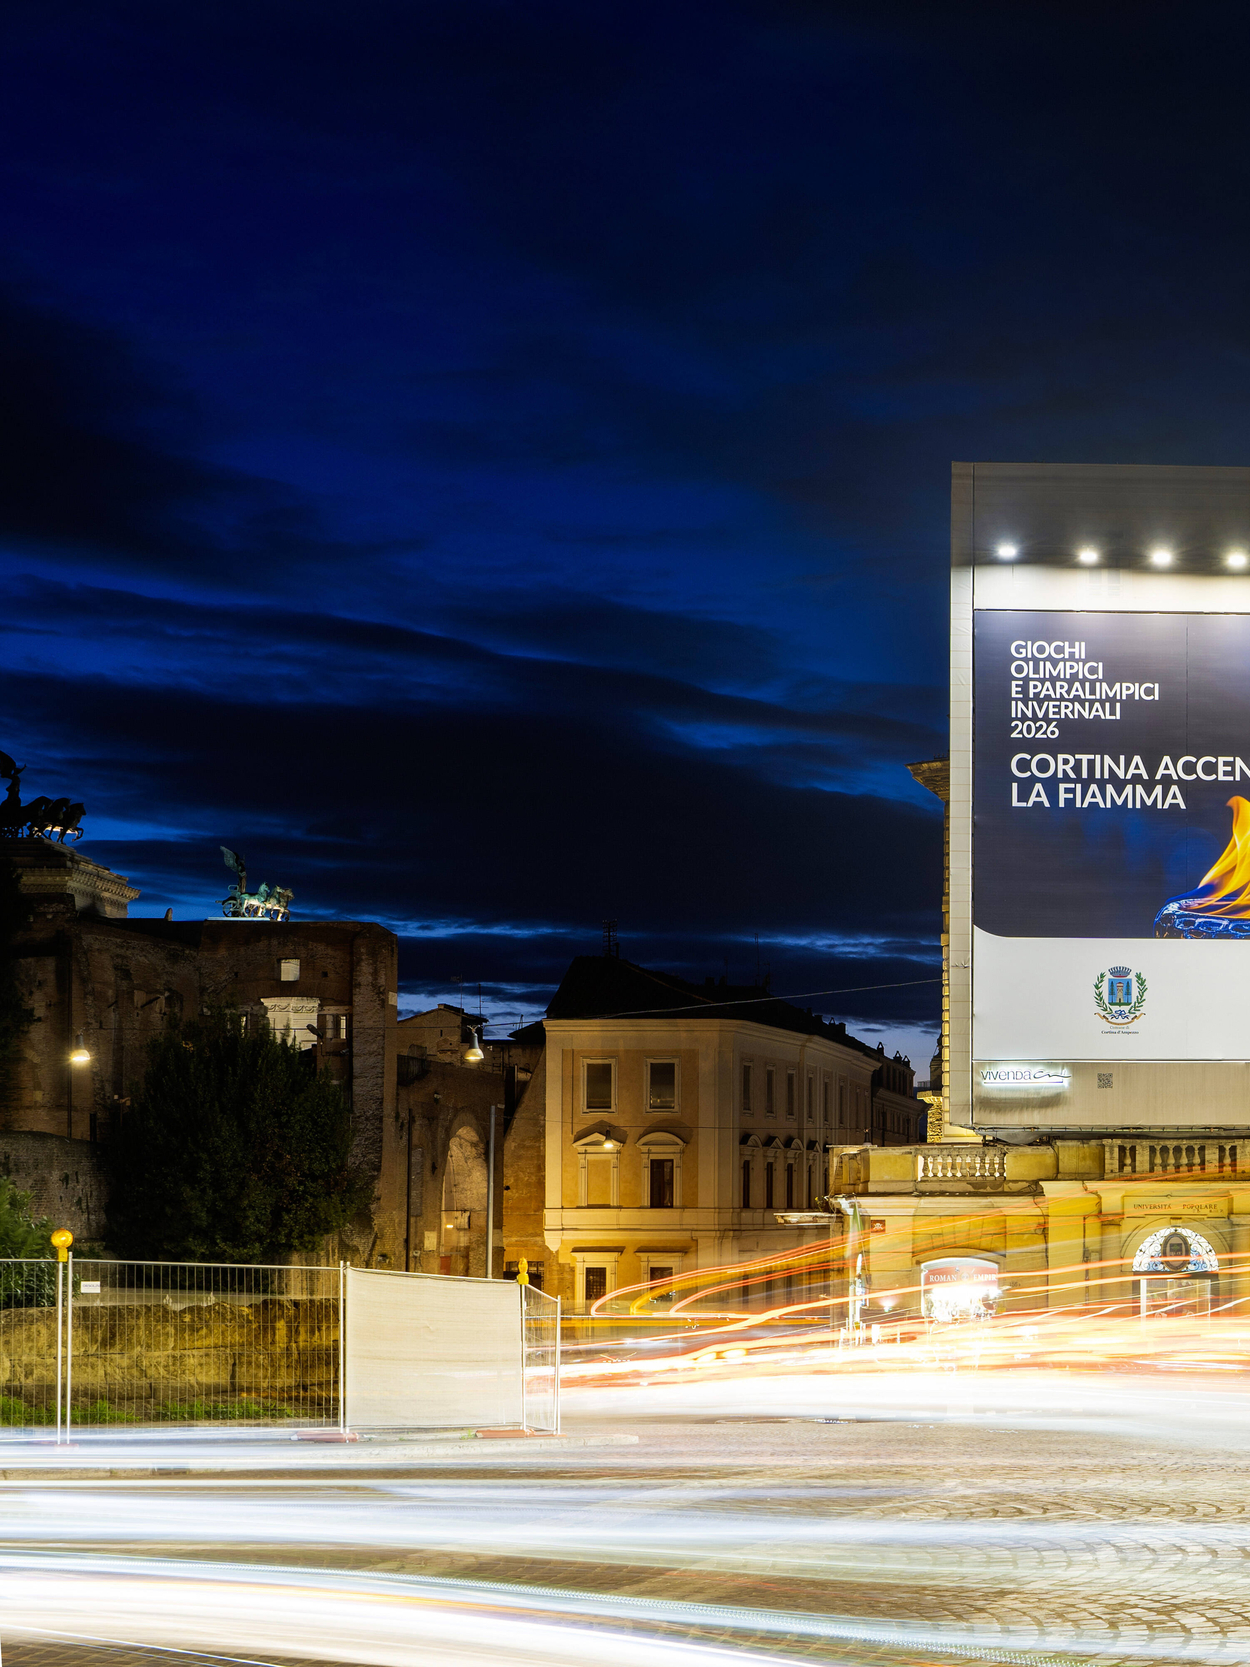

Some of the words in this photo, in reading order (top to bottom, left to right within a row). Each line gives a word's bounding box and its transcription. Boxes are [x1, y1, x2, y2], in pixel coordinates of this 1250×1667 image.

[1010, 640, 1086, 659] GIOCHI
[1010, 660, 1103, 680] OLIMPICI
[1011, 680, 1024, 698] E
[1028, 681, 1160, 701] PARALIMPICI
[1011, 700, 1121, 720] INVERNALI
[1010, 720, 1060, 739] 2026
[1010, 753, 1149, 780] CORTINA
[1011, 782, 1051, 808] LA
[1058, 783, 1187, 810] FIAMMA
[929, 1274, 957, 1282] ROMAN
